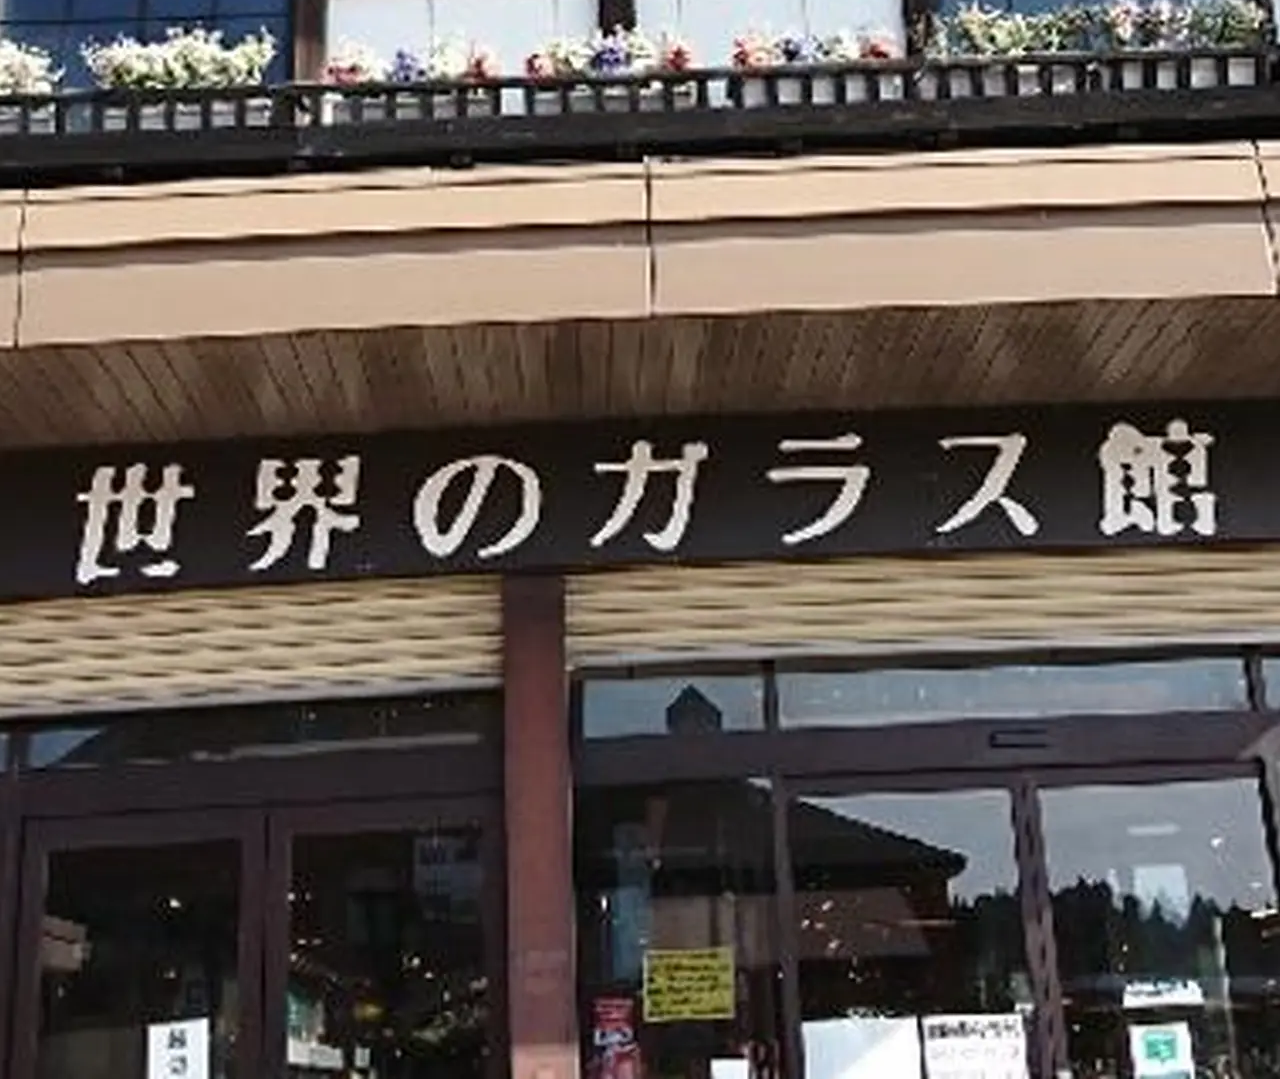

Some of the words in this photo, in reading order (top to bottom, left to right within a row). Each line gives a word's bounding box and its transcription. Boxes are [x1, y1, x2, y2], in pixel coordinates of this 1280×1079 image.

[75, 419, 1218, 585] 世界のガラス館
